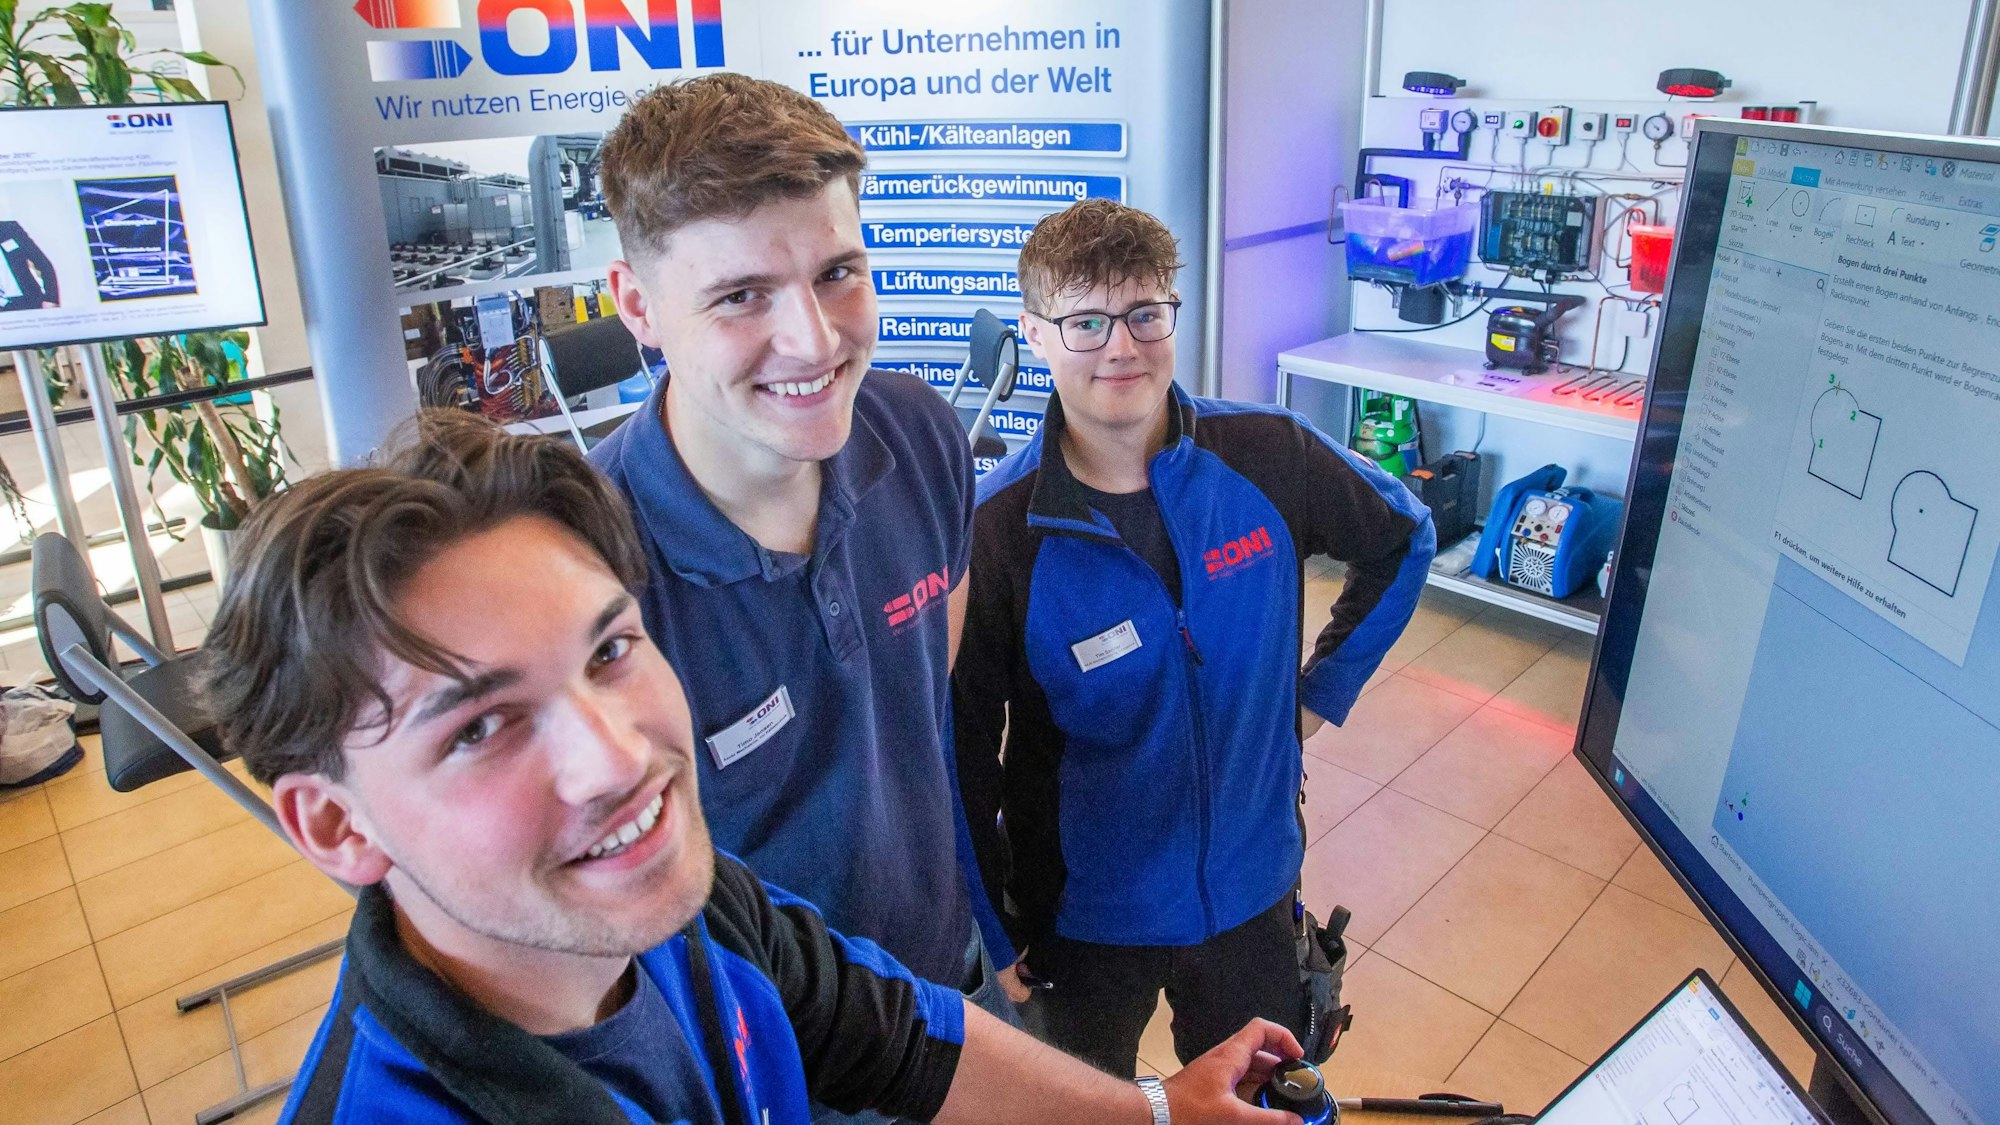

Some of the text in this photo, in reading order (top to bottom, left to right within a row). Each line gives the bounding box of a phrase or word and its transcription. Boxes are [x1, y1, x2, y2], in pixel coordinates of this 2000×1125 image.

[477, 0, 726, 76] ONI
[831, 30, 874, 57] für
[882, 24, 1086, 55] Unternehmen
[1095, 22, 1121, 49] in
[809, 66, 1112, 102] Europa und der Welt
[375, 93, 423, 121] Wir
[432, 93, 521, 118] nutzen
[530, 86, 626, 114] Energie
[127, 113, 173, 128] ONI
[860, 125, 1071, 149] Kühl-/Kälteanlagen
[1958, 167, 1996, 182] Material
[1836, 179, 1874, 193] Anmerkung
[1875, 184, 1906, 196] versehen
[1919, 190, 1944, 203] Prüfen
[1958, 196, 1983, 209] Extras
[1905, 213, 1941, 231] Rundung
[869, 223, 1032, 248] Temperiersyste
[1789, 223, 1803, 233] Kreis
[1813, 227, 1835, 239] Bogen
[1845, 233, 1875, 249] Rechteck
[1901, 236, 1915, 248] Text
[881, 272, 1020, 294] Lüftungsanla
[1837, 255, 1928, 285] Bogen durch drei Punkte
[1833, 274, 1855, 288] Erstellt
[1855, 281, 1875, 293] einen
[1875, 285, 1899, 301] Bogen
[1899, 292, 1929, 308] anhand
[1929, 301, 1944, 312] von
[1823, 318, 2000, 384] Geben Sie die ersten beiden Punkte zur Begrenzu
[1820, 332, 1844, 348] Bogens
[1855, 343, 1868, 356] Mit
[1868, 348, 1885, 363] dem
[1885, 354, 1910, 371] dritten
[1910, 362, 1933, 379] Punkt
[1933, 371, 1951, 385] wird
[1963, 380, 2000, 402] Bogenra
[1828, 373, 1836, 385] 3
[1850, 410, 1857, 421] 2
[1818, 438, 1824, 449] 1
[1222, 525, 1272, 566] ONI
[1774, 530, 1907, 619] F1 drücken, um weitere Hilfe zu erhalten
[1108, 624, 1127, 639] ONI
[756, 695, 780, 719] ONI
[1836, 1032, 1863, 1069] Suche
